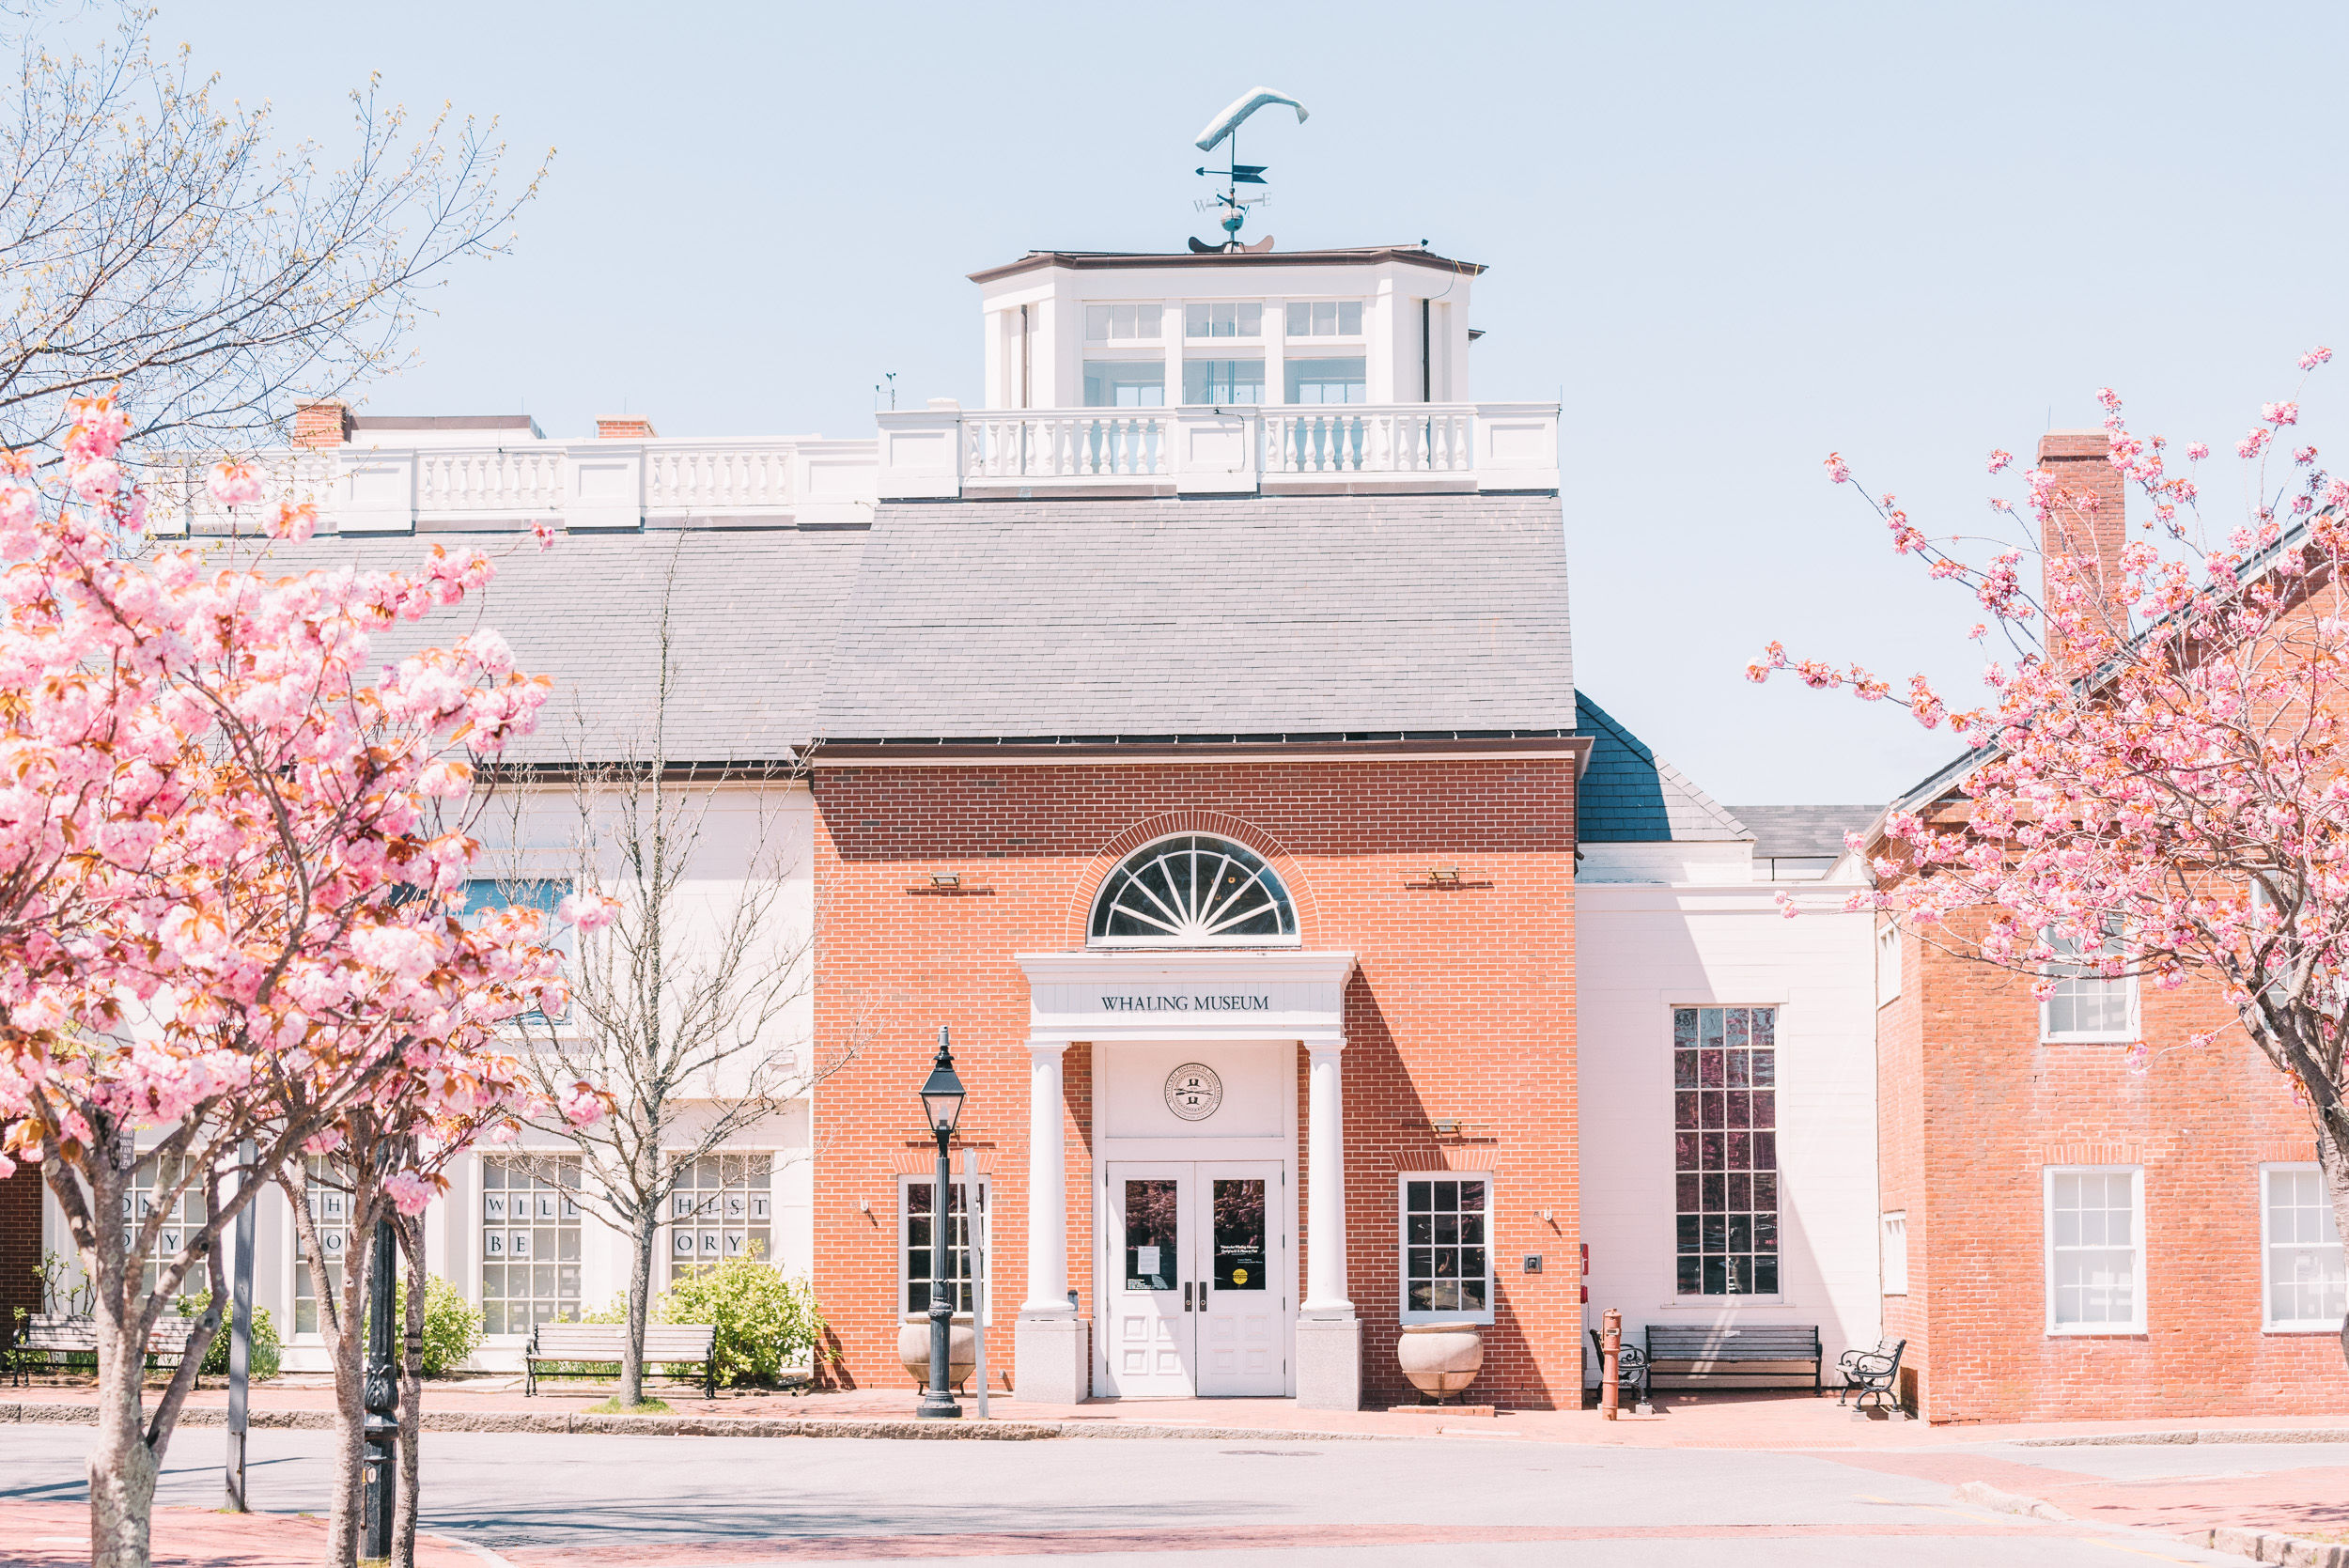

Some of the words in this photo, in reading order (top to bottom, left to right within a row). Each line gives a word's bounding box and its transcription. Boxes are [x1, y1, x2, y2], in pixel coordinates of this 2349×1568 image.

[1101, 996, 1189, 1011] WHALING
[1194, 996, 1269, 1011] MUSEUM
[489, 1199, 577, 1216] WILL
[678, 1199, 768, 1216] HIST
[490, 1235, 526, 1252] BE
[677, 1235, 741, 1251] ORY
